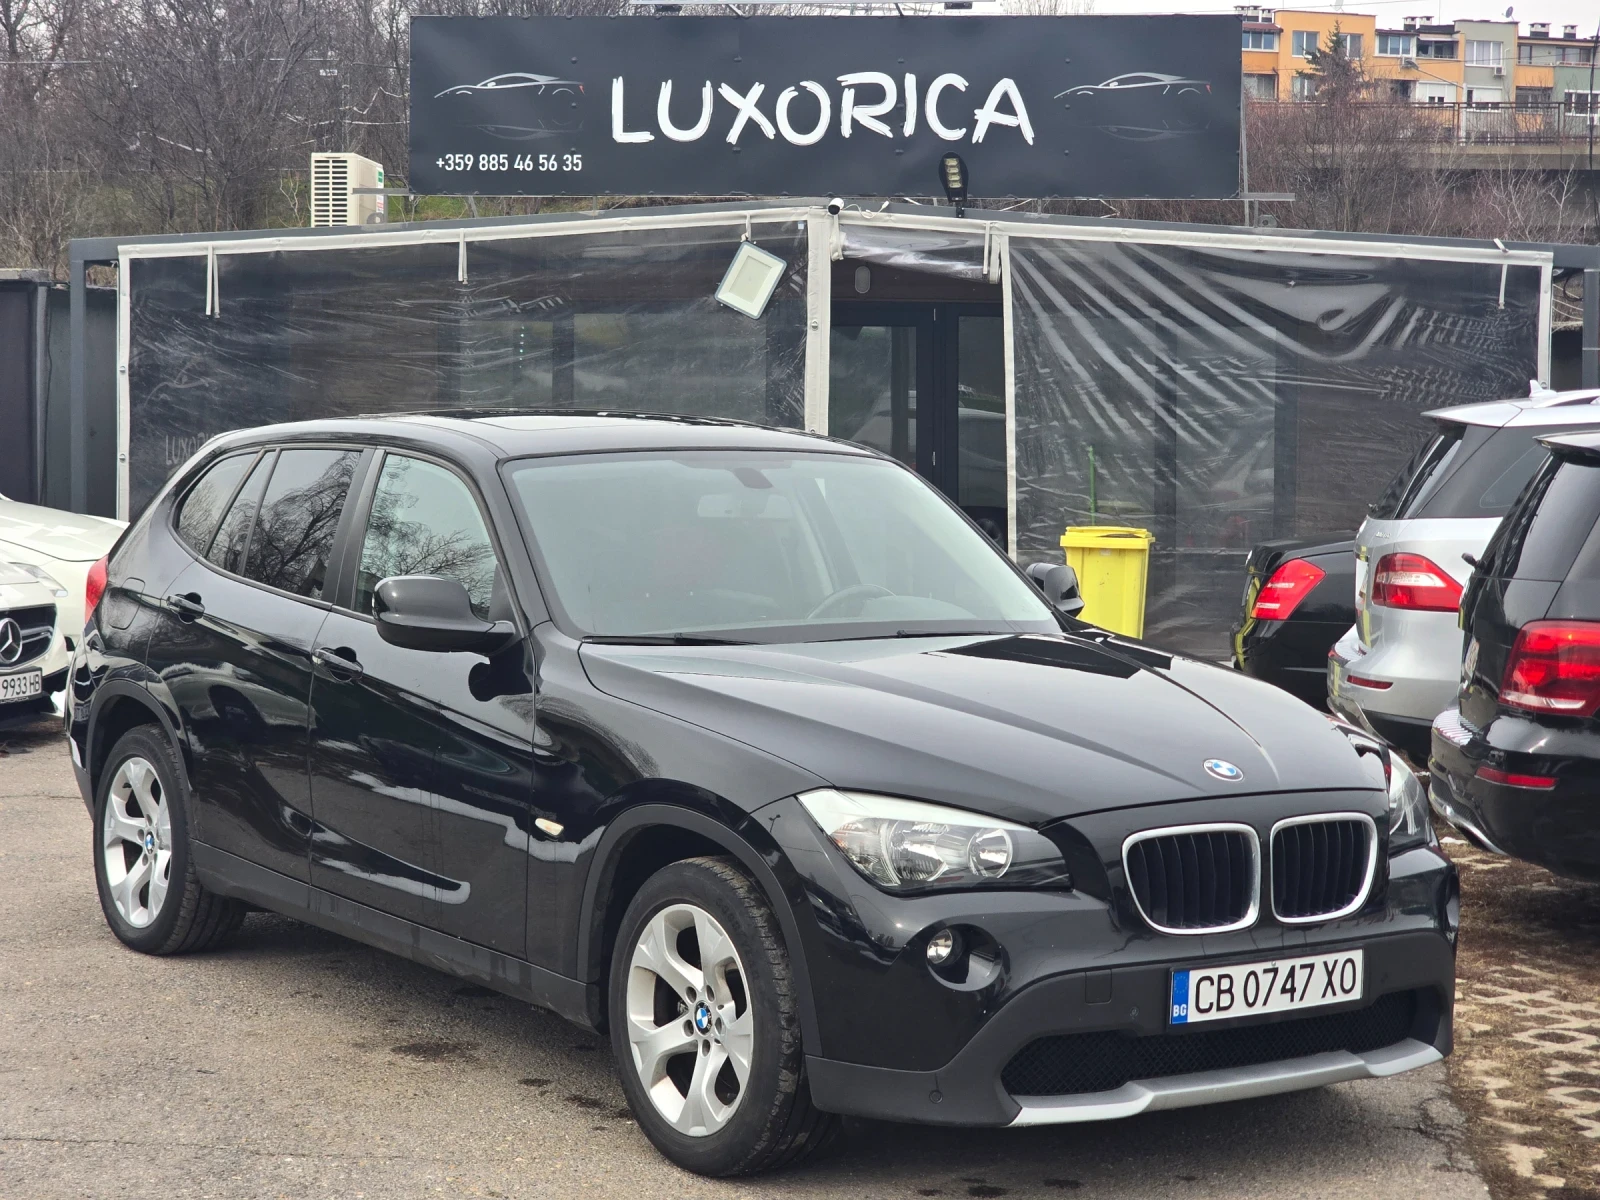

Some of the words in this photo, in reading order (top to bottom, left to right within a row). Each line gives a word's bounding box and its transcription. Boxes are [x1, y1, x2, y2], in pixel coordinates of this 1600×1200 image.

[611, 71, 1035, 146] LUXORICA
[435, 153, 474, 171] +359
[479, 154, 509, 171] 885
[513, 154, 534, 171] 46
[538, 154, 558, 171] 56
[562, 154, 583, 171] 35
[1, 676, 28, 698] 9933
[29, 673, 41, 693] HB
[1195, 973, 1235, 1014] CB
[1243, 962, 1316, 1008] 0747
[1321, 957, 1357, 999] XO
[1172, 1004, 1187, 1017] BG
